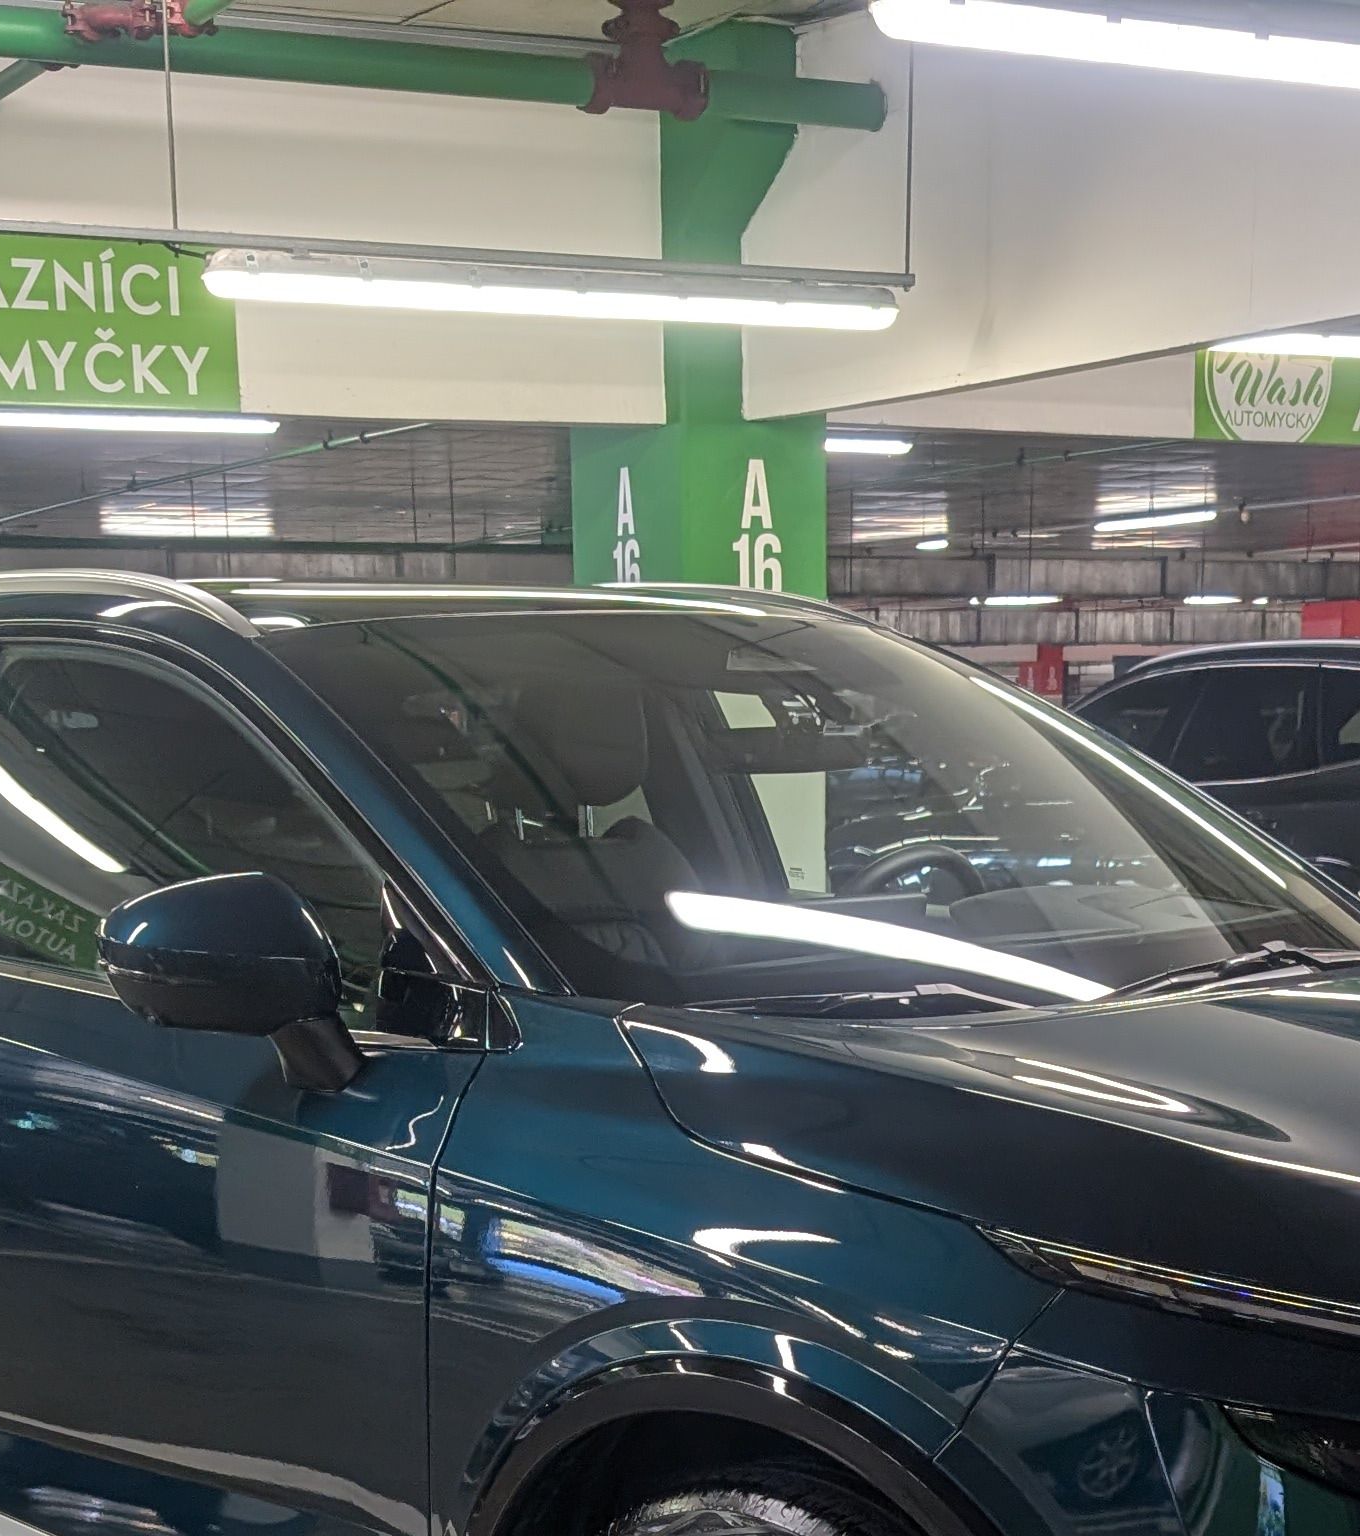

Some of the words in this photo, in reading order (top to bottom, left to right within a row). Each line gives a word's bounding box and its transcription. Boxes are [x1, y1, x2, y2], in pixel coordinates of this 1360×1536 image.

[1230, 354, 1325, 406] Wash
[617, 467, 635, 536] A
[741, 459, 773, 529] A
[613, 539, 640, 583] 16
[733, 533, 782, 592] 16
